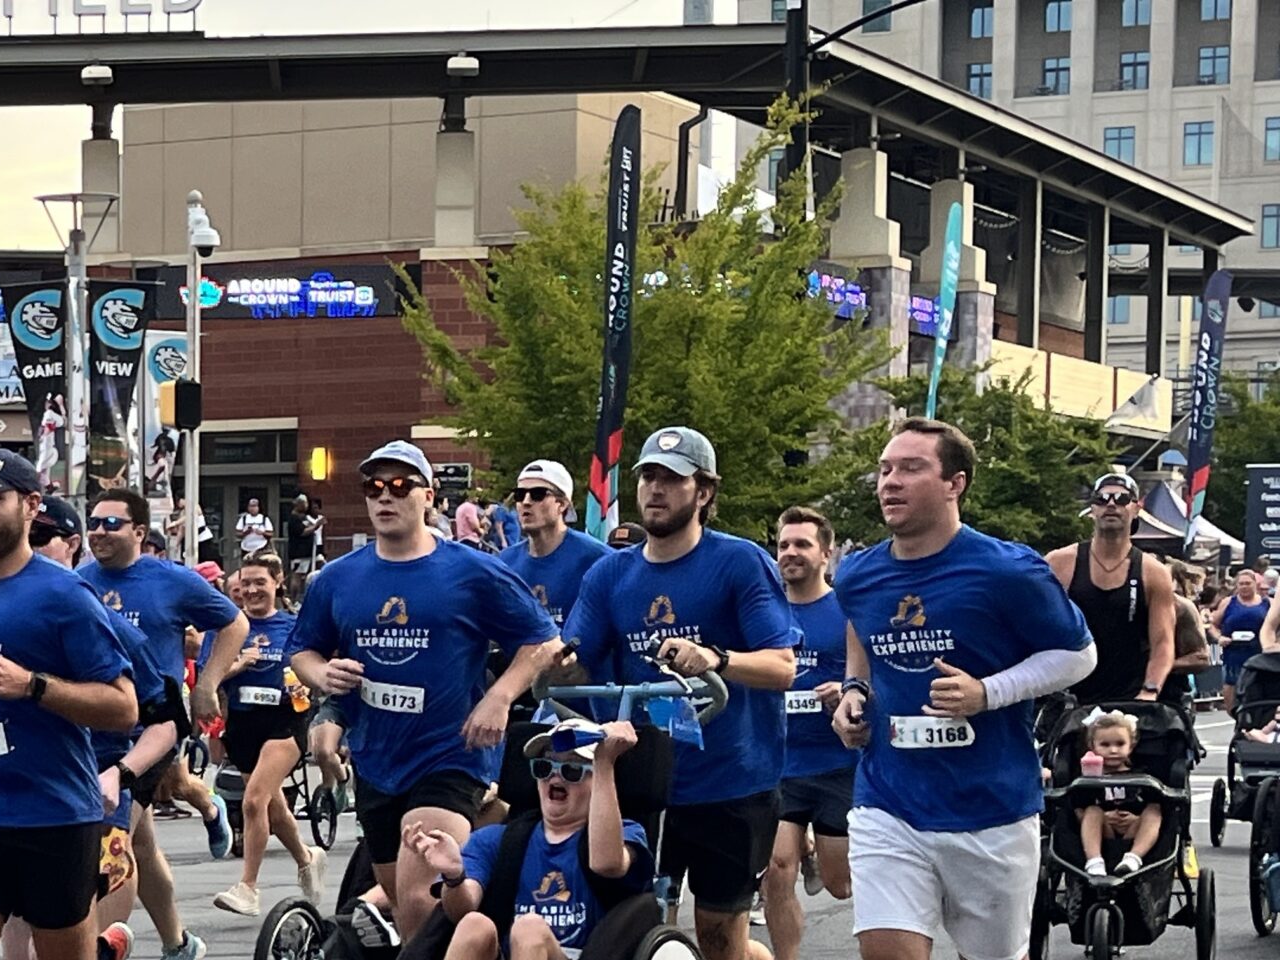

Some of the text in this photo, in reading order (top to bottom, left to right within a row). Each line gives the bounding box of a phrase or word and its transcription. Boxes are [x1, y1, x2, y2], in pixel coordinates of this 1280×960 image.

[226, 278, 301, 294] AROUND
[240, 294, 289, 305] CROWN
[308, 290, 355, 302] TRUIST
[22, 361, 63, 380] GAME
[94, 361, 134, 377] VIEW
[1200, 356, 1220, 430] CROWN
[355, 628, 430, 637] THE ABILITY
[626, 630, 648, 641] THE
[870, 629, 952, 644] THE ABILITY
[356, 637, 429, 649] EXPERIENCE
[872, 638, 955, 656] EXPERIENCE
[381, 693, 417, 710] 6173
[786, 698, 817, 710] 4349
[925, 726, 969, 744] 3168
